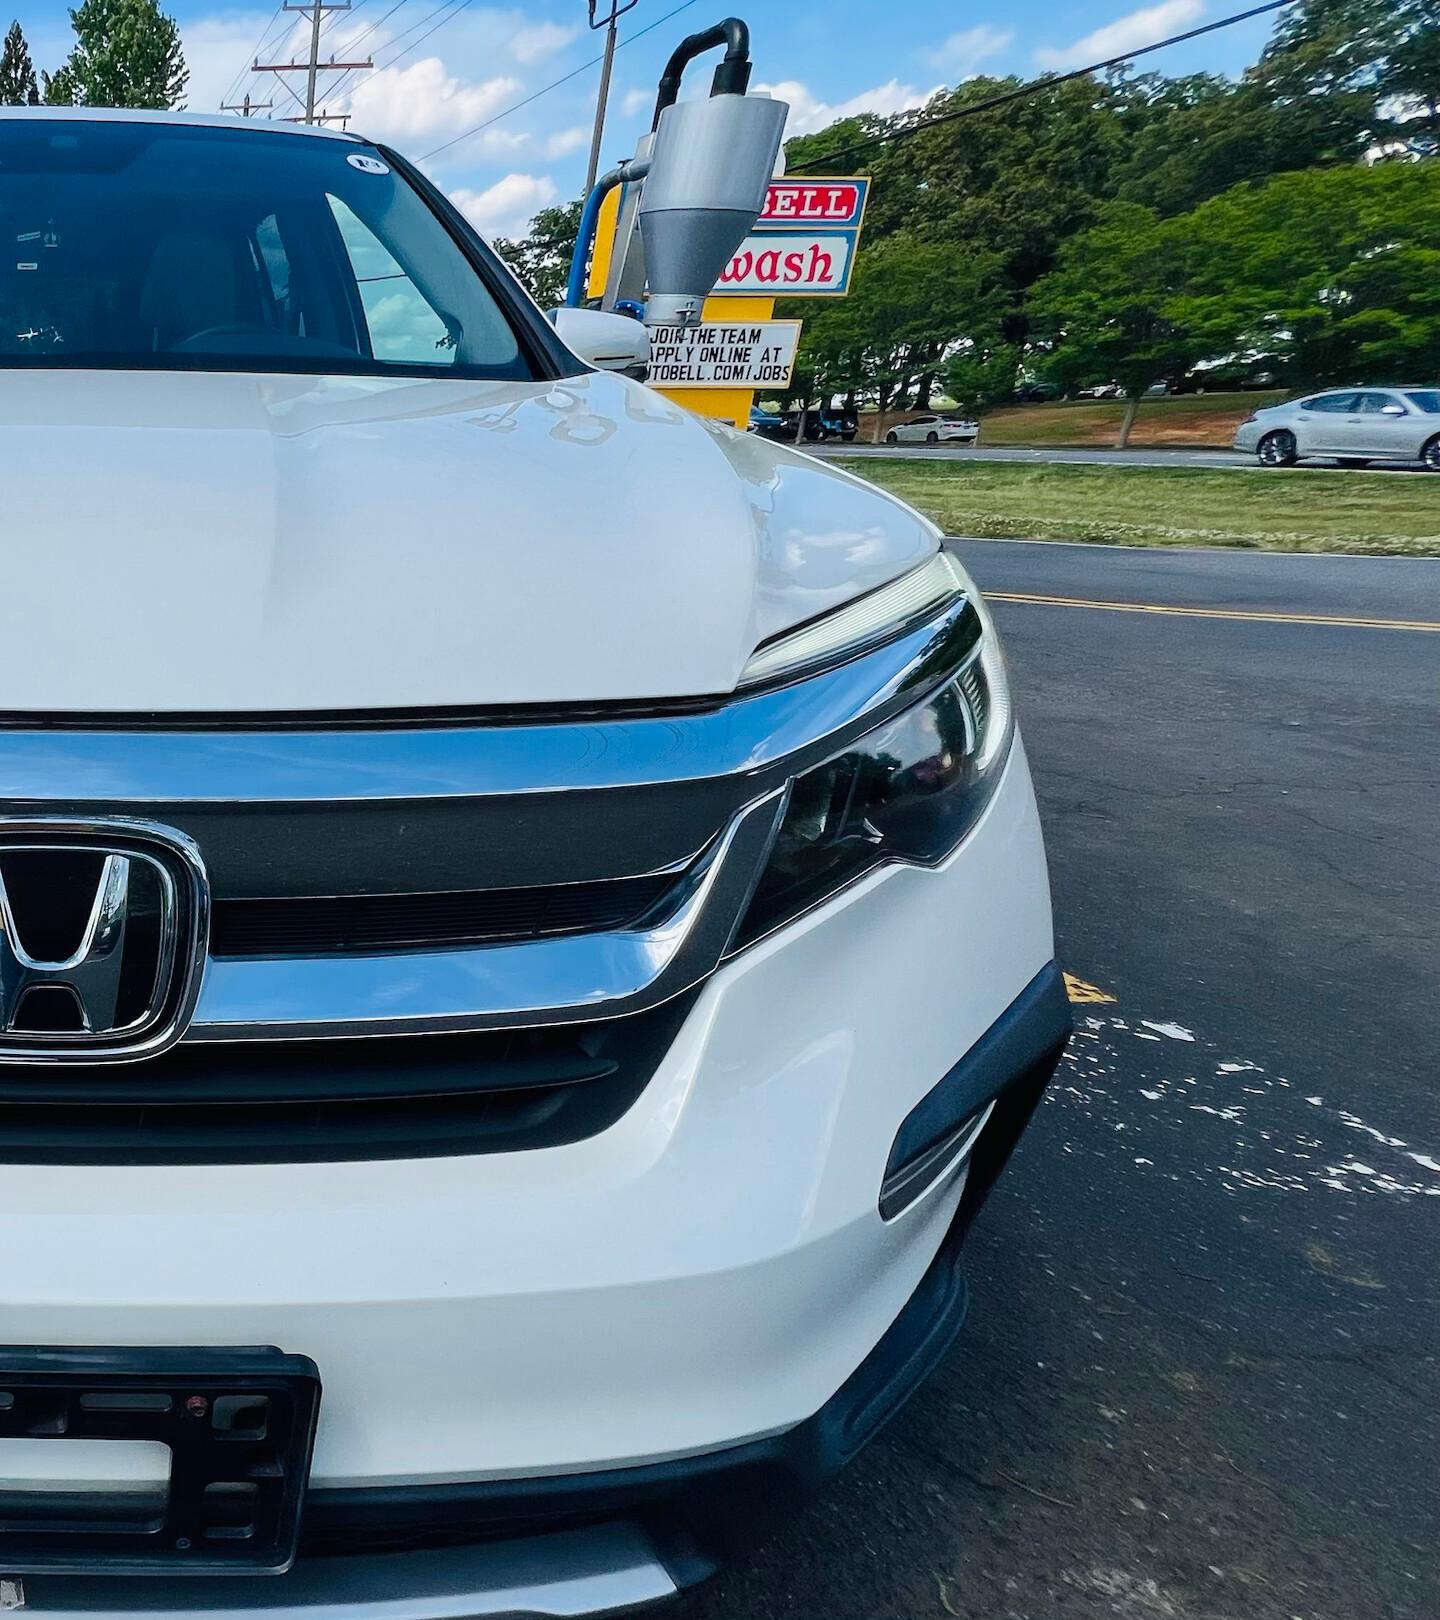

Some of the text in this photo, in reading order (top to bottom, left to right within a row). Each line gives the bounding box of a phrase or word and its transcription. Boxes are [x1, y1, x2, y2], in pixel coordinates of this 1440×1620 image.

[650, 328, 762, 344] JOIN THE TEAM
[699, 346, 752, 362] ONLINE
[760, 346, 782, 362] AT
